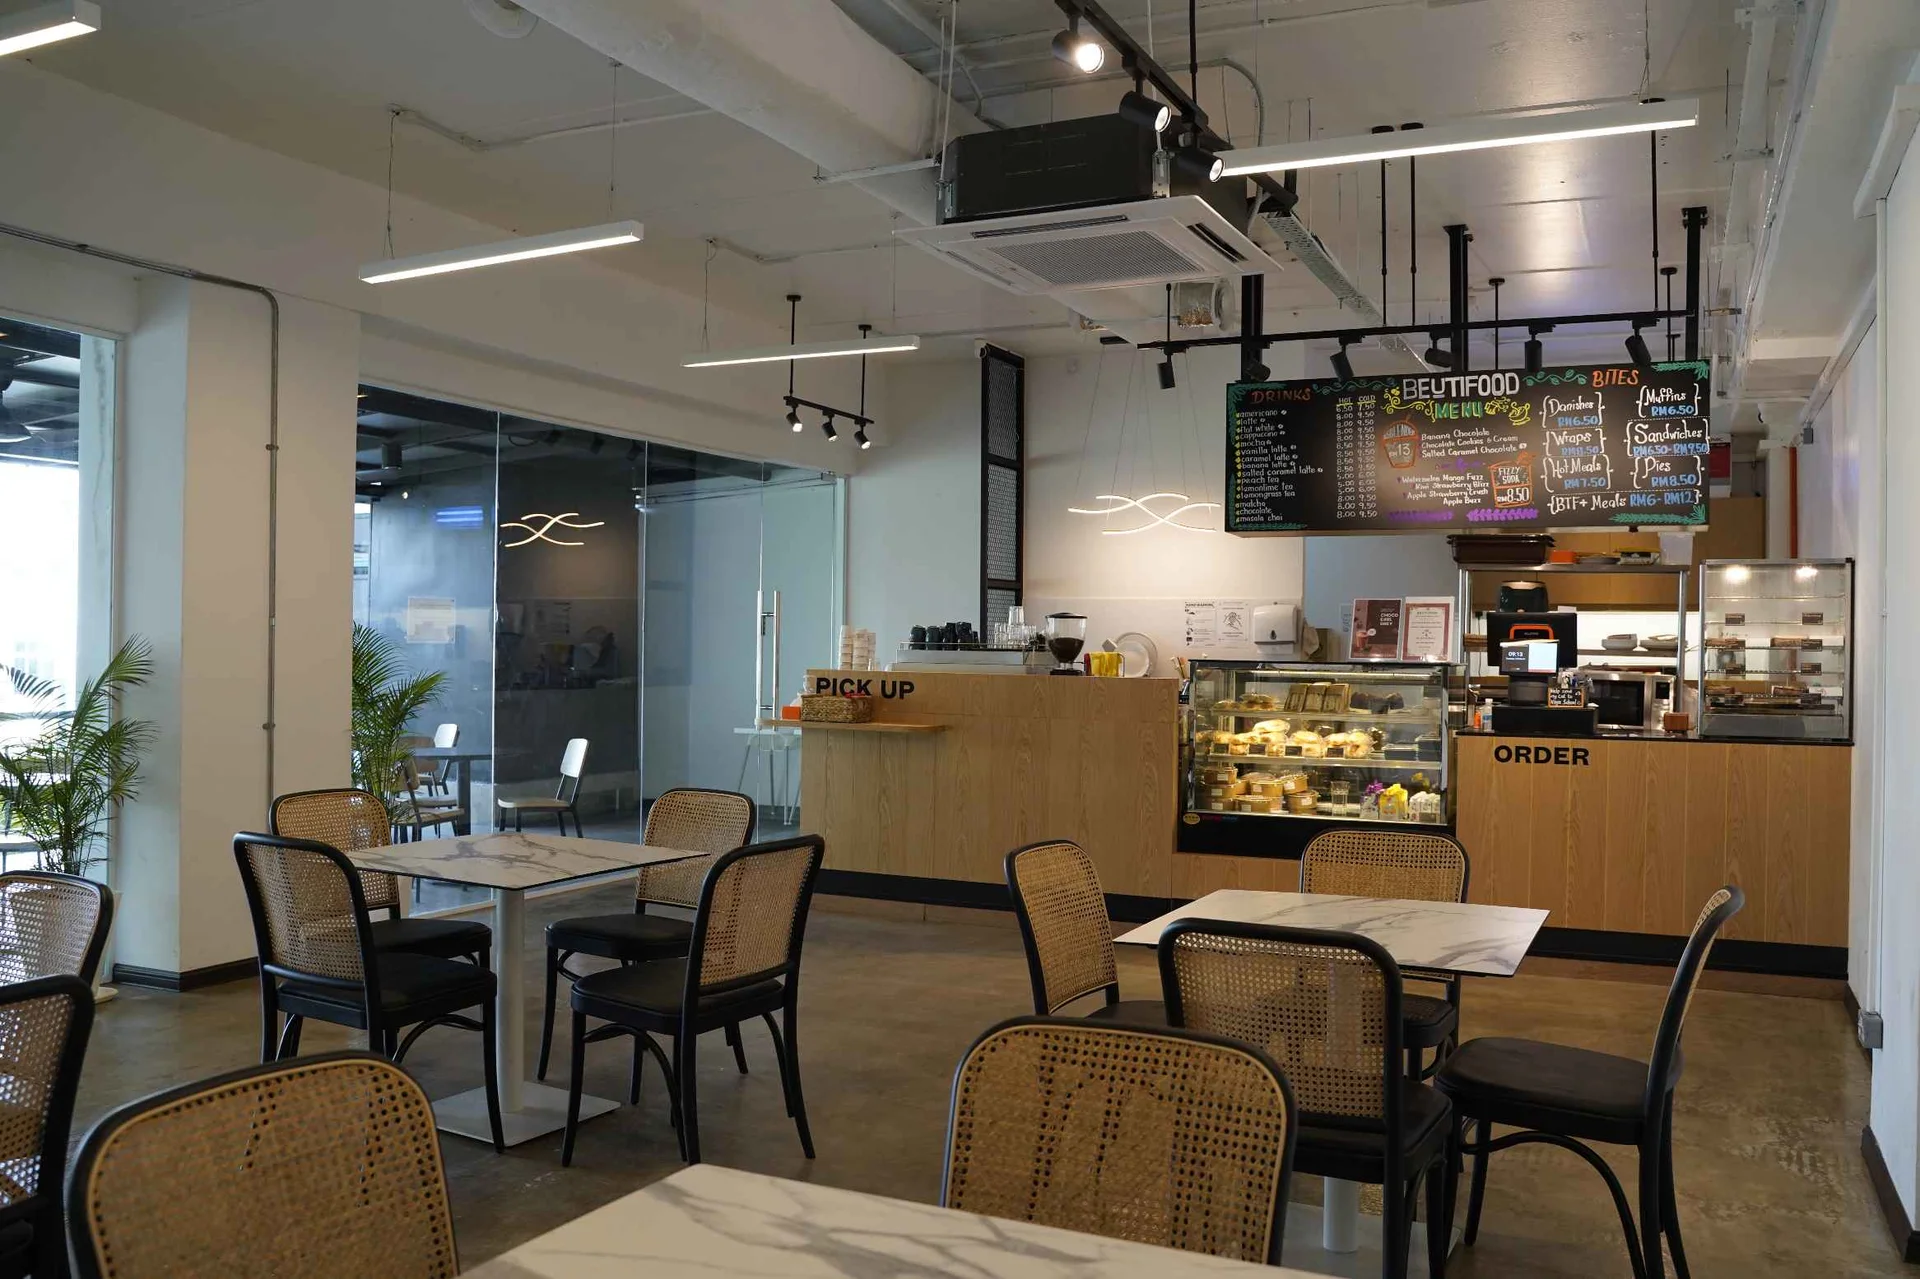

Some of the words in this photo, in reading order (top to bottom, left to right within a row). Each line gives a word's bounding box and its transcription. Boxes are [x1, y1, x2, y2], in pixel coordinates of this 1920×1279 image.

[1592, 369, 1639, 387] BITES
[1403, 373, 1519, 400] BEUTIFOOD
[1252, 388, 1311, 404] DRINKS
[1644, 388, 1686, 406] Muffins
[1434, 401, 1484, 419] MENU
[1549, 396, 1594, 417] Danishes
[1652, 405, 1694, 416] RM6.50
[1240, 410, 1278, 418] americano
[1255, 423, 1275, 431] white
[1557, 416, 1598, 427] RM6.50
[1240, 431, 1278, 440] cappuccino
[1453, 428, 1489, 437] Chocolate
[1634, 420, 1702, 444] Sandwiches
[1241, 439, 1265, 447] mocha
[1422, 440, 1455, 449] Chocolate
[1457, 438, 1483, 446] Cookies
[1551, 432, 1592, 446] Wraps
[1241, 447, 1268, 455] vanilla
[1271, 445, 1287, 453] latte
[1422, 449, 1445, 458] Salted
[1448, 447, 1478, 456] Caramel
[1480, 442, 1517, 453] Chocolate
[1242, 454, 1271, 462] caramel
[1242, 461, 1268, 469] banana
[1549, 458, 1569, 478] Hot
[1570, 456, 1601, 473] Meals
[1642, 457, 1671, 478] Pies
[1242, 469, 1264, 477] salted
[1267, 466, 1296, 475] caramel
[1299, 465, 1315, 474] latte
[1498, 467, 1520, 476] FIZZY
[1242, 476, 1265, 484] peach
[1401, 475, 1440, 483] Watermelon
[1443, 474, 1465, 483] Mango
[1564, 477, 1606, 489] RM7.50
[1652, 474, 1696, 487] RM8.50
[1282, 482, 1293, 490] tea
[1432, 482, 1471, 491] Strawberry
[1407, 491, 1427, 500] Apple
[1429, 489, 1468, 497] Strawberry
[1240, 499, 1265, 508] matcha
[1443, 498, 1462, 507] Apple
[1590, 494, 1626, 510] Meals
[1268, 513, 1282, 521] chai
[816, 678, 872, 698] PICK
[881, 680, 914, 699] UP
[1494, 744, 1590, 765] ORDER
